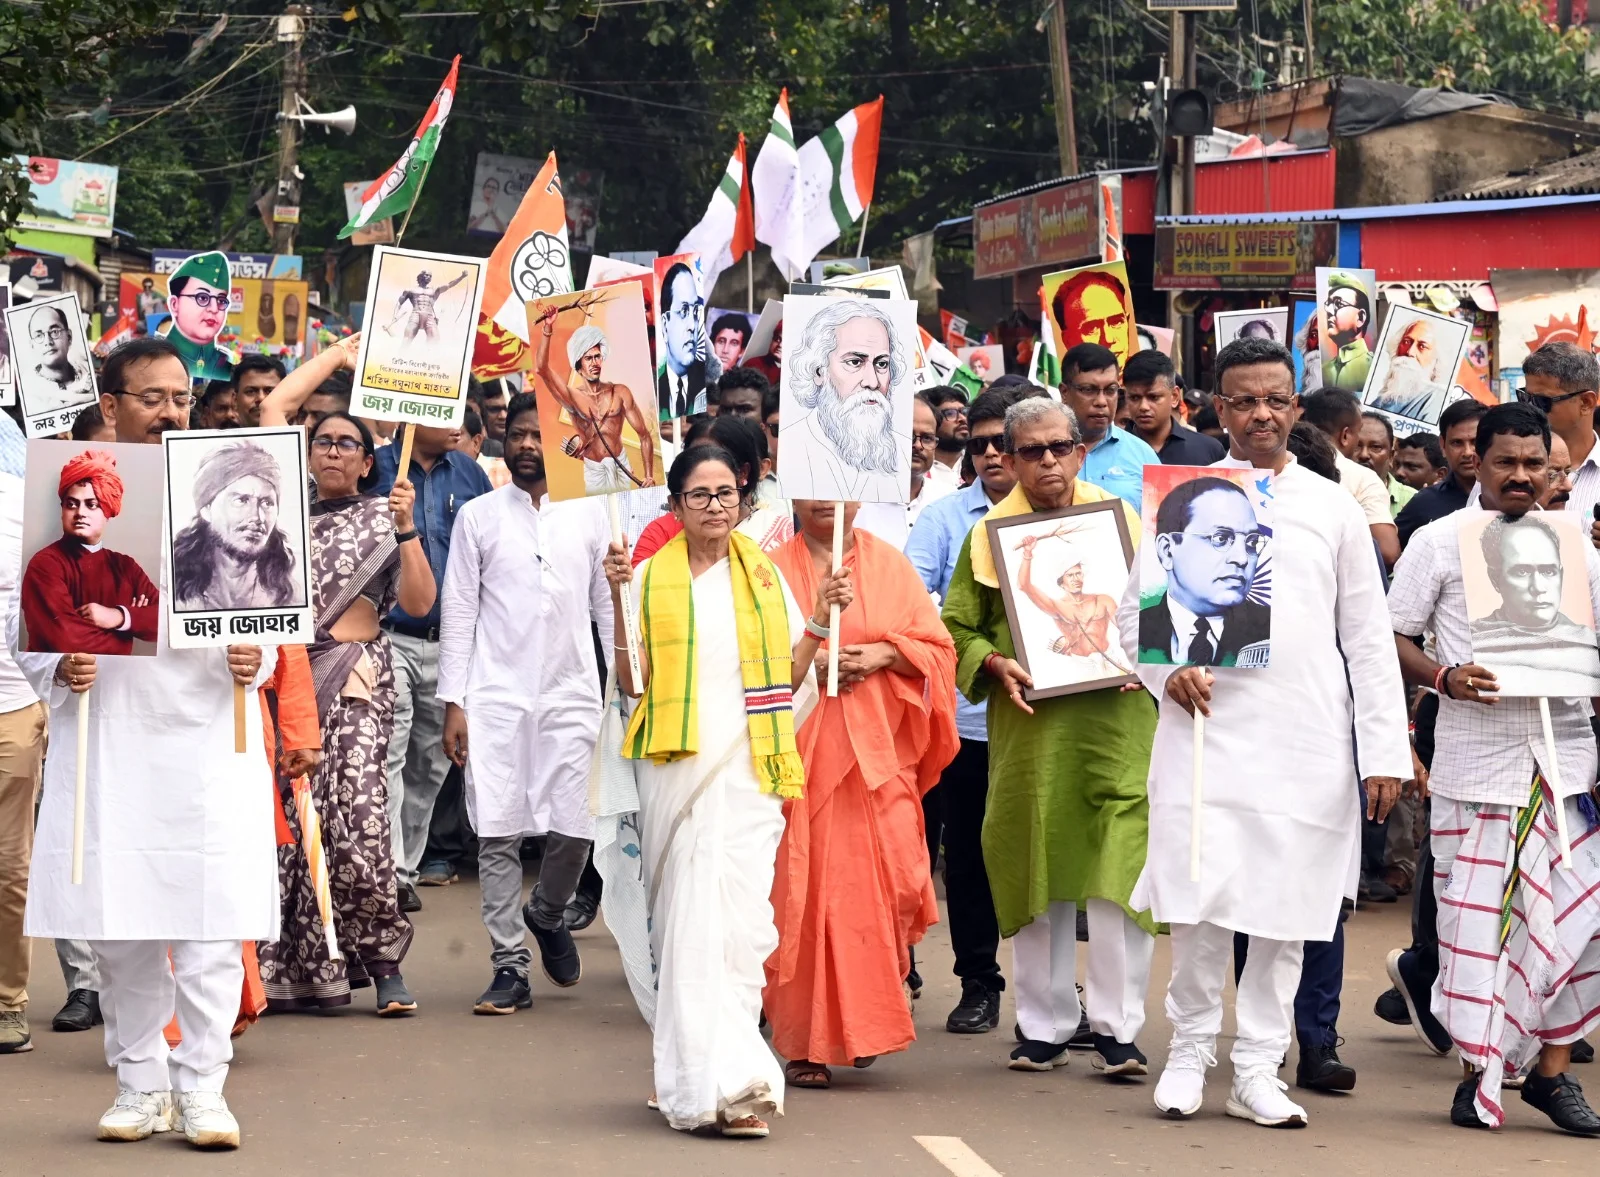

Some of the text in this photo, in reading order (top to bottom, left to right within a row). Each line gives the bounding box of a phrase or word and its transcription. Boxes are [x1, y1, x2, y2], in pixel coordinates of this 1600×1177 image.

[1176, 230, 1296, 258] SONALI SWEETS
[367, 373, 390, 385] শহিদ
[392, 378, 422, 391] রঘুনাথ
[362, 394, 455, 421] জয় জোহার
[33, 416, 56, 430] লহ
[183, 614, 300, 638] জয় জোহার
